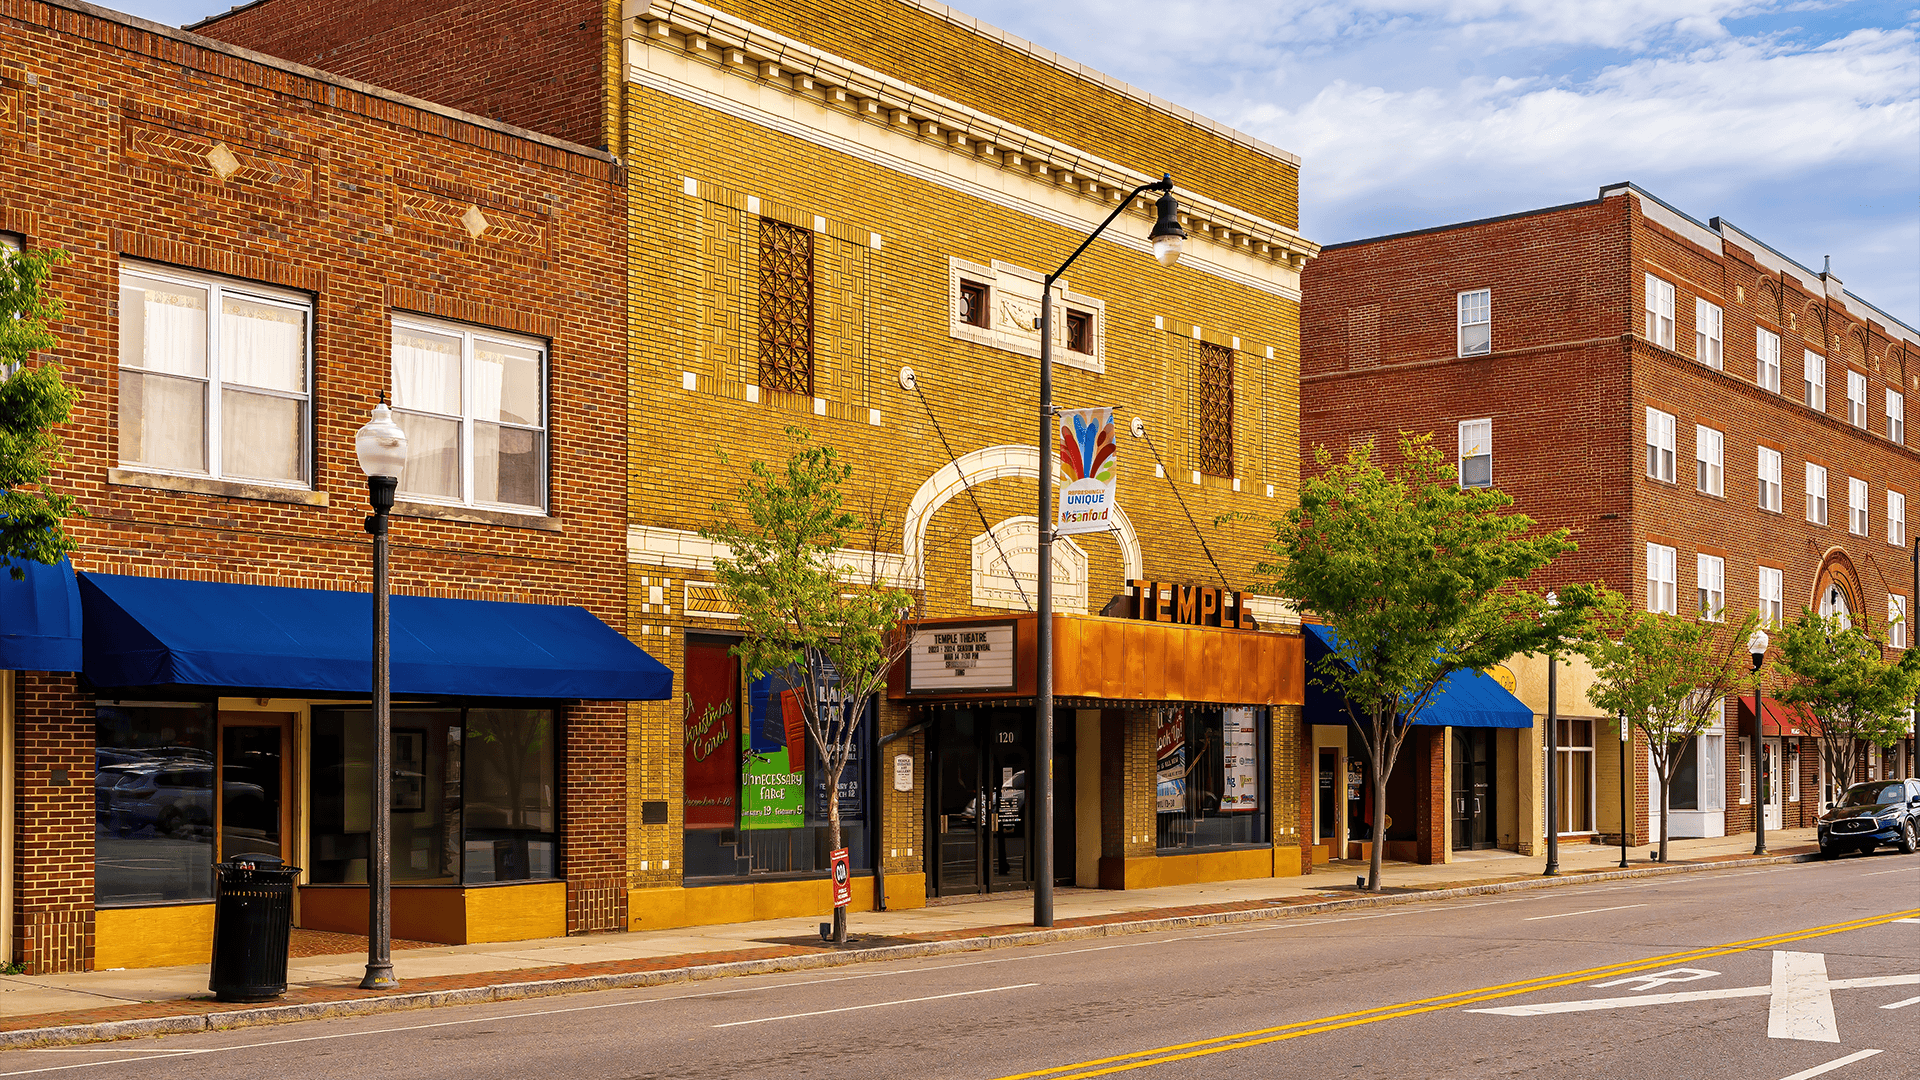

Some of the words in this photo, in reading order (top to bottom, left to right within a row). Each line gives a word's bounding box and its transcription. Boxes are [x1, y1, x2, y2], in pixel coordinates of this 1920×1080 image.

[1068, 494, 1104, 505] UNIQUE
[1072, 508, 1108, 522] sanford
[1128, 579, 1254, 630] TEMPLE
[934, 634, 957, 644] TEMPLE
[960, 632, 986, 643] THEATRE
[685, 692, 695, 720] A
[693, 720, 729, 762] Carol
[999, 732, 1014, 743] 120
[764, 805, 772, 816] 19
[797, 804, 803, 815] 5
